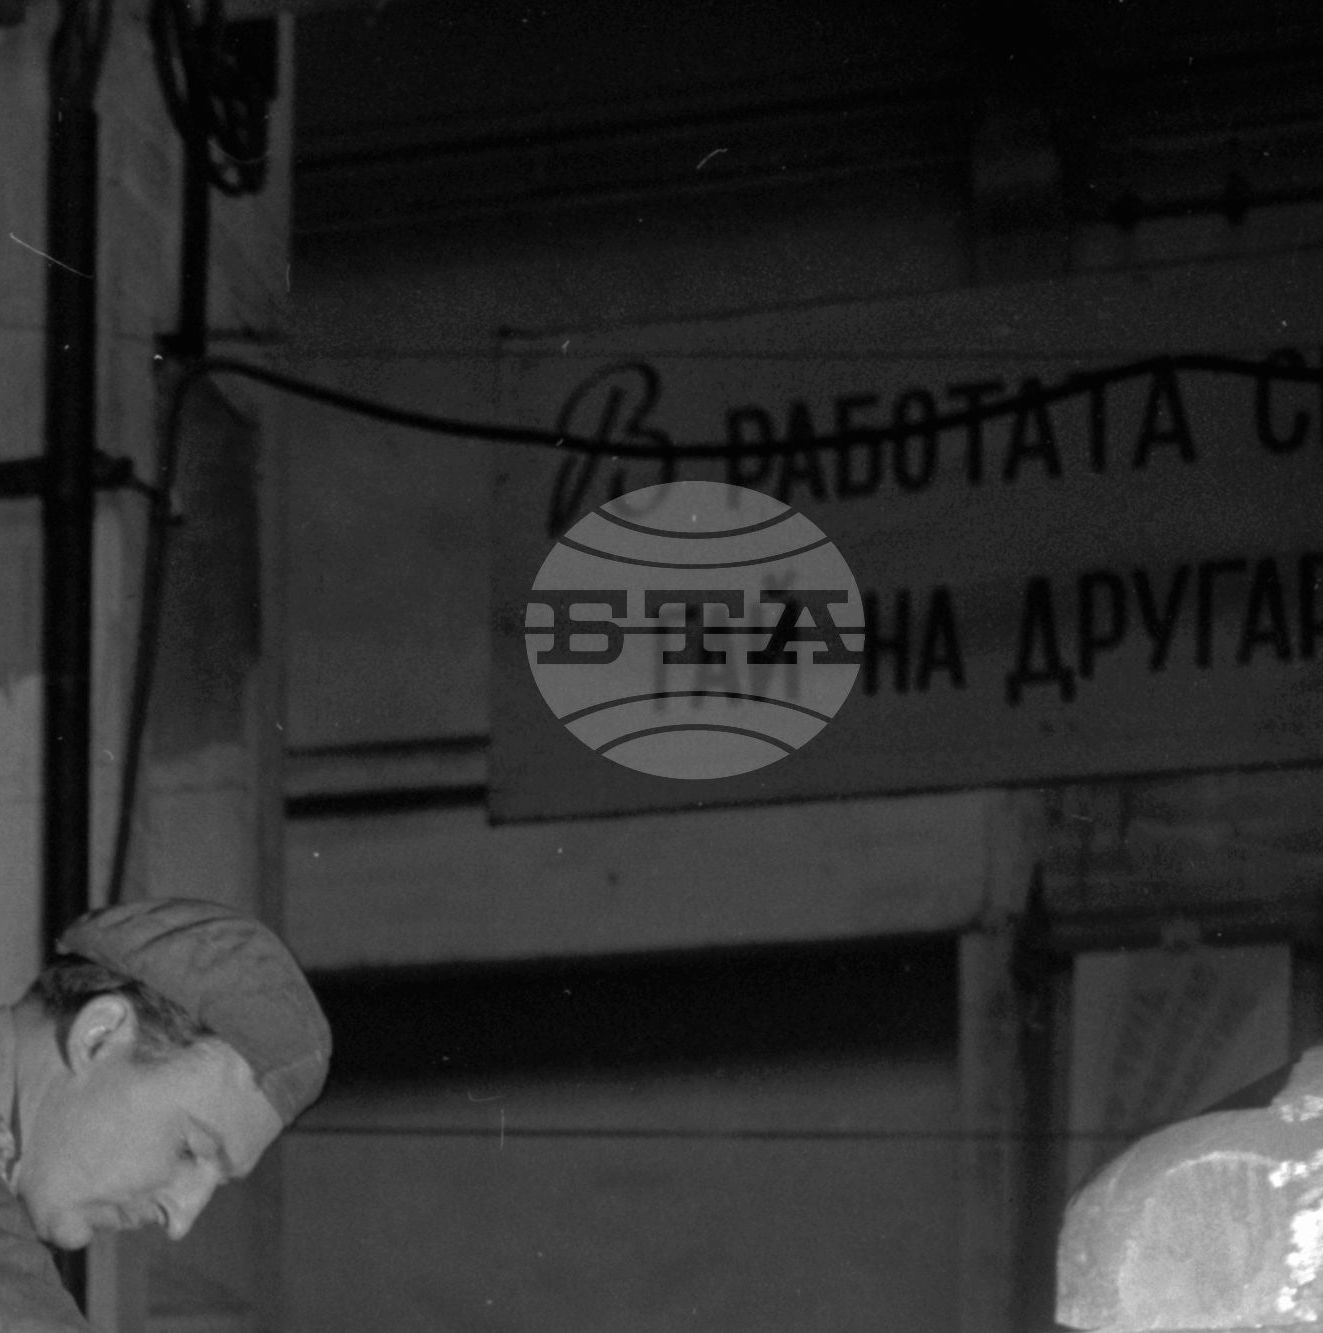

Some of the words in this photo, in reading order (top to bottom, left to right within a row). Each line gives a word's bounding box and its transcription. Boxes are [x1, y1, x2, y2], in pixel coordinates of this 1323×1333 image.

[725, 356, 1196, 508] РАБОТАТА
[1256, 348, 1323, 452] С
[862, 585, 966, 697] НА
